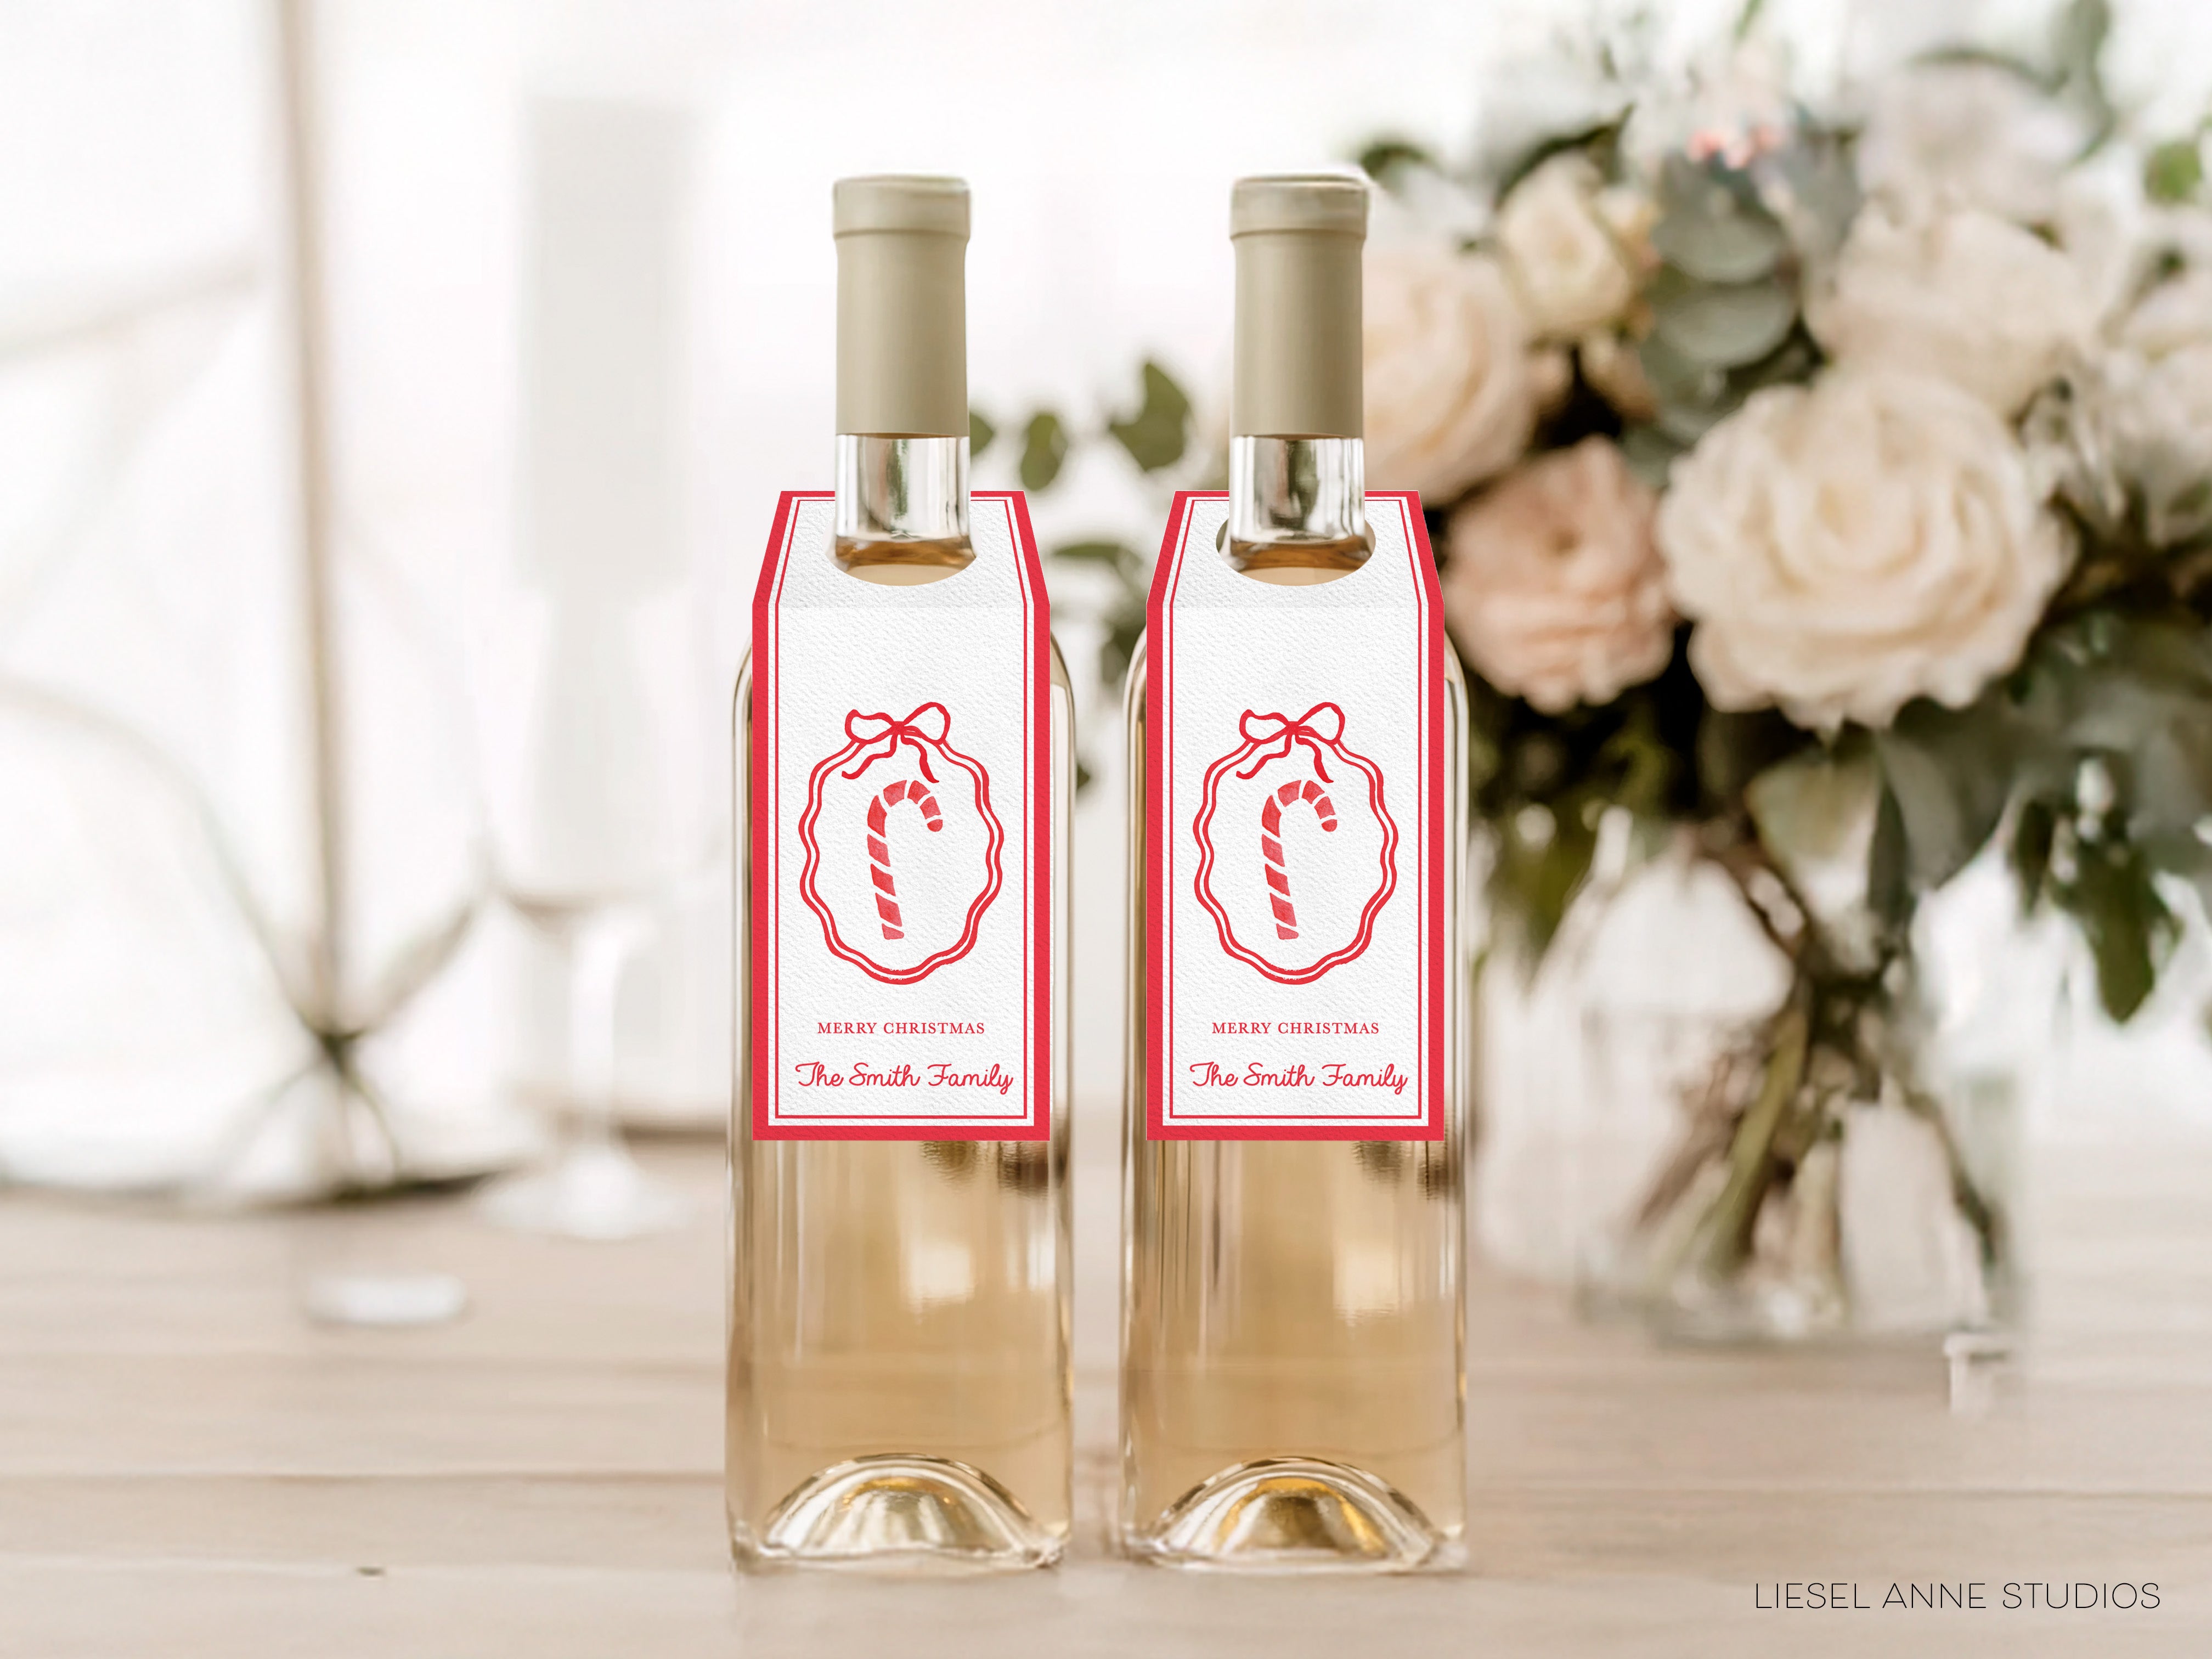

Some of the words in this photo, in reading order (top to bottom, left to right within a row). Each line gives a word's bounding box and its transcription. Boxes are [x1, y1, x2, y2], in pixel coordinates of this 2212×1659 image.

[817, 1022, 877, 1034] MERRY
[883, 1022, 985, 1034] CHRISTMAS
[1212, 1022, 1272, 1034] MERRY
[1278, 1022, 1379, 1034] CHRISTMAS
[795, 1062, 844, 1087] The
[849, 1062, 921, 1087] Smith
[927, 1063, 1013, 1095] Family
[1189, 1062, 1238, 1087] The
[1243, 1062, 1315, 1087] Smith
[1322, 1063, 1408, 1095] Family
